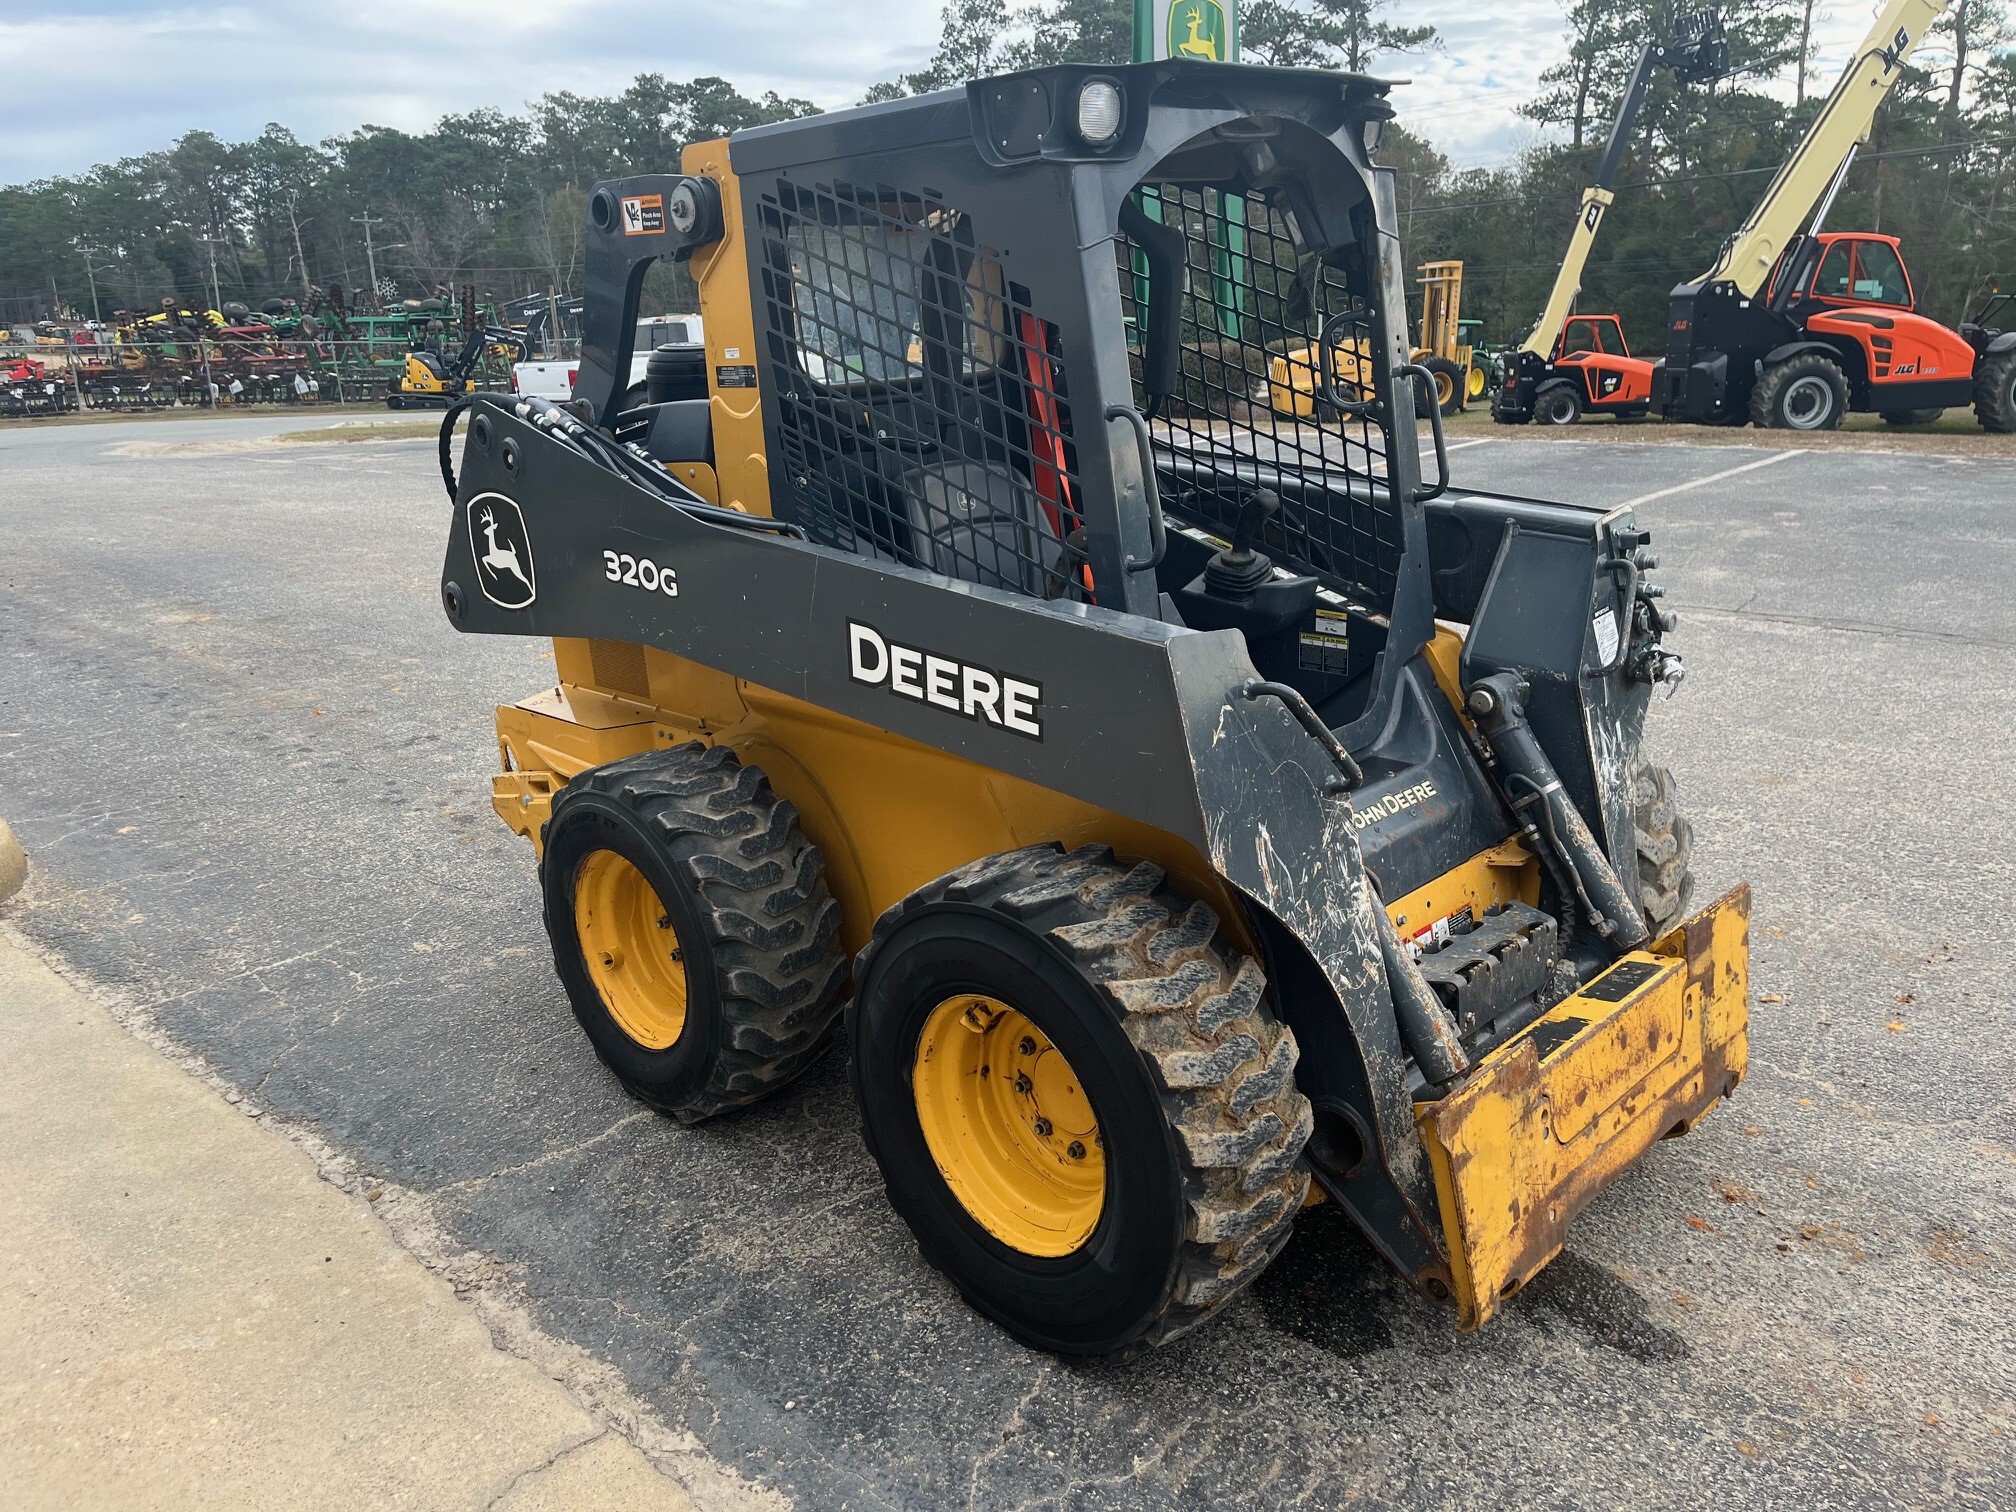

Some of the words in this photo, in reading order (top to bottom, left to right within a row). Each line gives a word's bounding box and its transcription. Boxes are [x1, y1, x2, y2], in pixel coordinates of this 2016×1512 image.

[1883, 25, 1909, 77] JLG
[1894, 364, 1916, 375] JLG
[602, 549, 679, 598] 320G
[849, 622, 1040, 737] DEERE
[1353, 803, 1389, 829] OHN
[1382, 780, 1438, 815] DEERE
